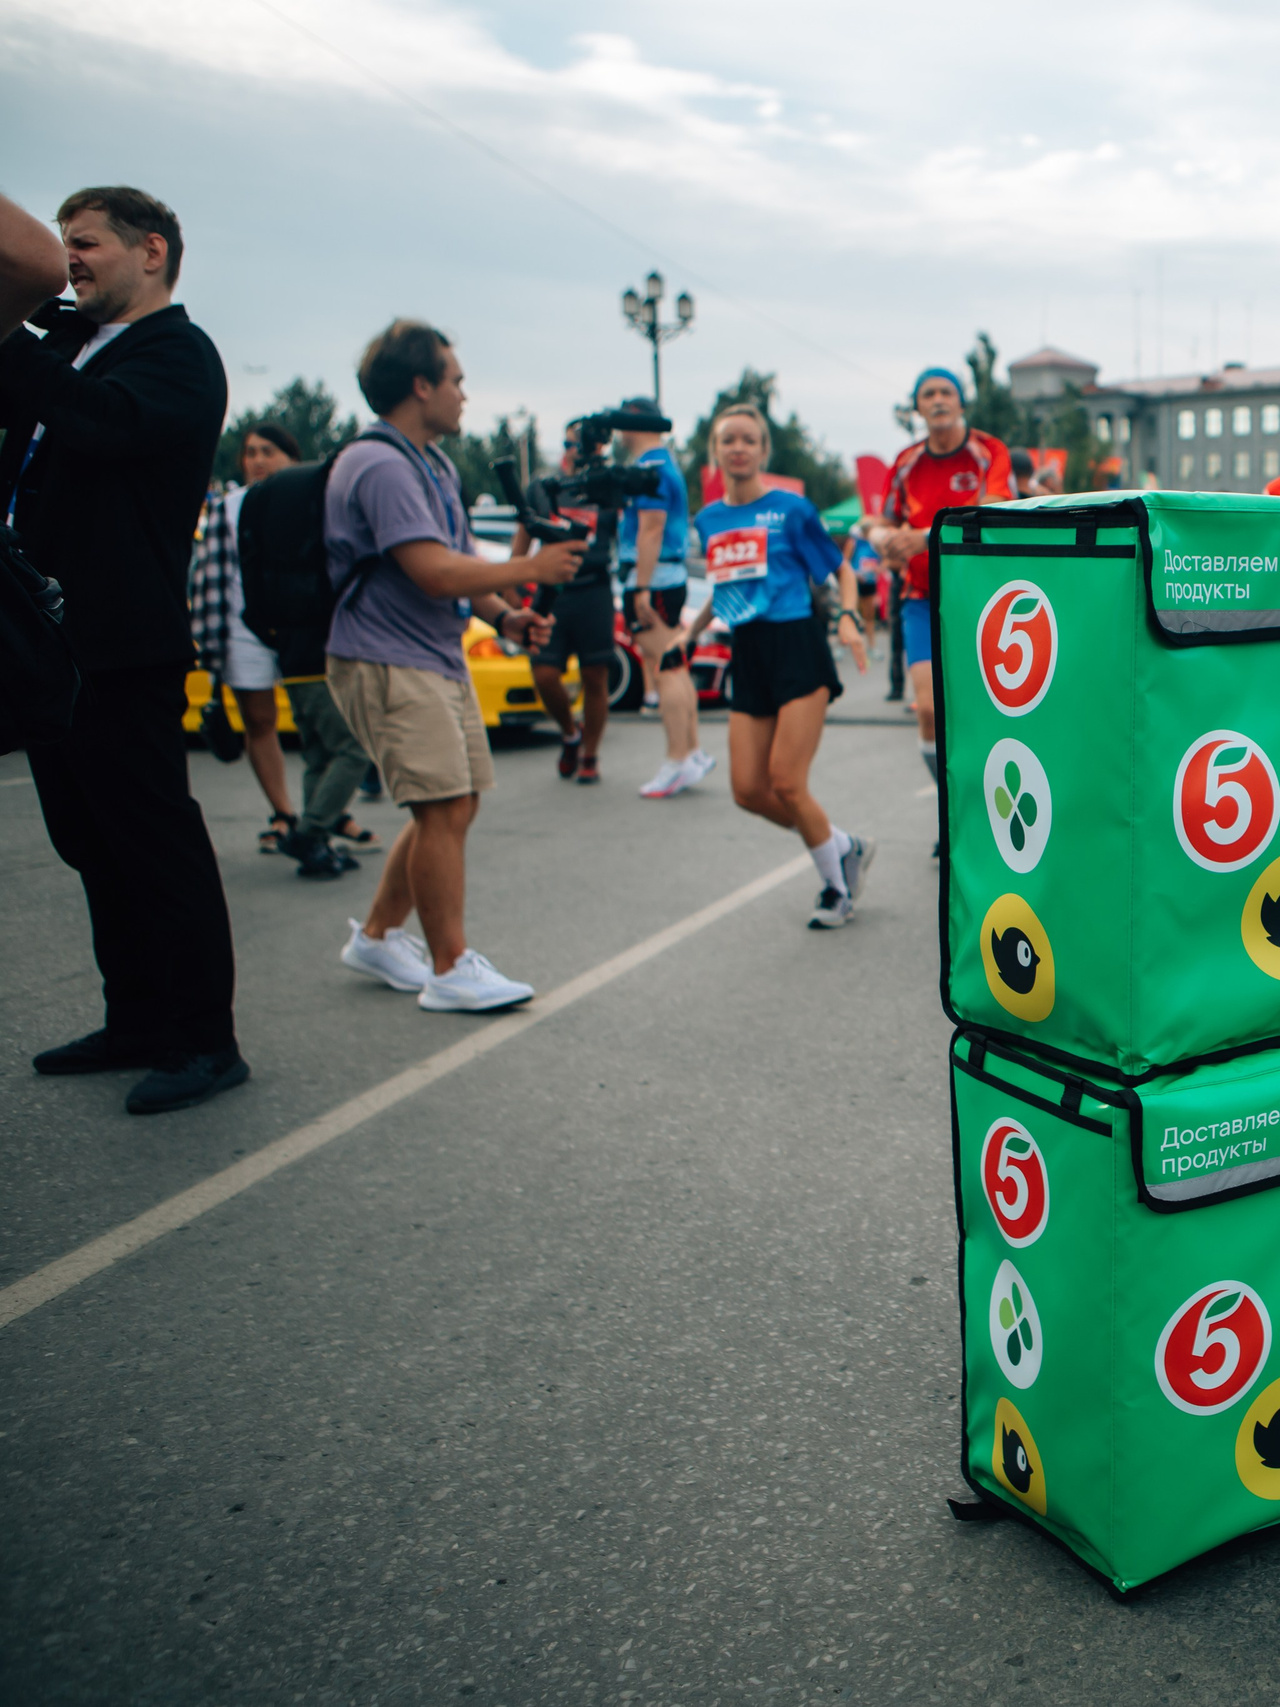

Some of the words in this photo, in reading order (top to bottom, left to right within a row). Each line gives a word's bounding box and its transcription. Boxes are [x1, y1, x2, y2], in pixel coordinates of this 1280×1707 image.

[1164, 549, 1278, 574] Доставляем
[1165, 582, 1250, 605] продукты
[1161, 1137, 1267, 1177] продукты
